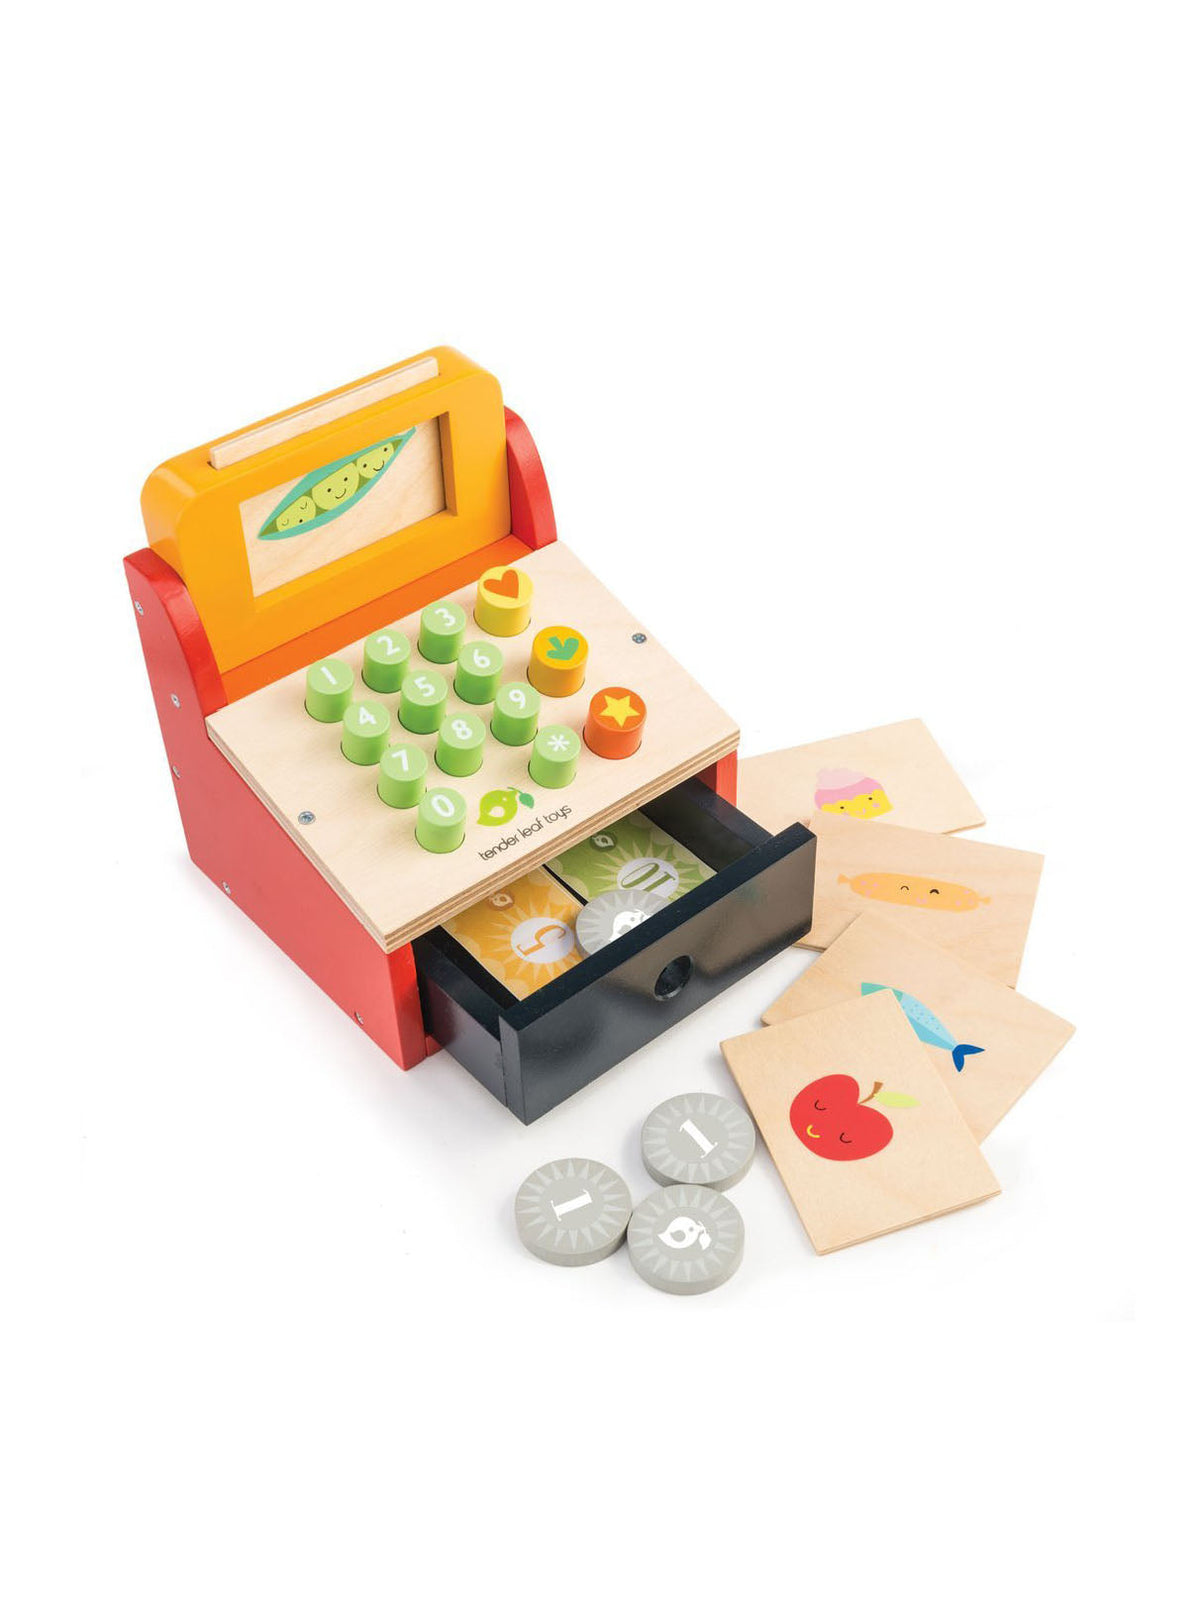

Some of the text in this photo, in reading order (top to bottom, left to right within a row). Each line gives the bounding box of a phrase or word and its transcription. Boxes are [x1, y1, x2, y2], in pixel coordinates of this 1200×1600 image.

[435, 607, 456, 627] 3
[377, 635, 400, 656] 2
[473, 650, 491, 668] 6
[320, 666, 338, 685] 1
[414, 676, 435, 697] 5
[508, 689, 527, 709] 9
[358, 707, 377, 726] 4
[452, 719, 472, 739] 8
[392, 750, 409, 772] 7
[431, 794, 455, 817] 0
[478, 805, 572, 860] tender leaf toys
[517, 925, 567, 956] 5
[679, 1119, 718, 1159] 1
[551, 1188, 592, 1222] 1
